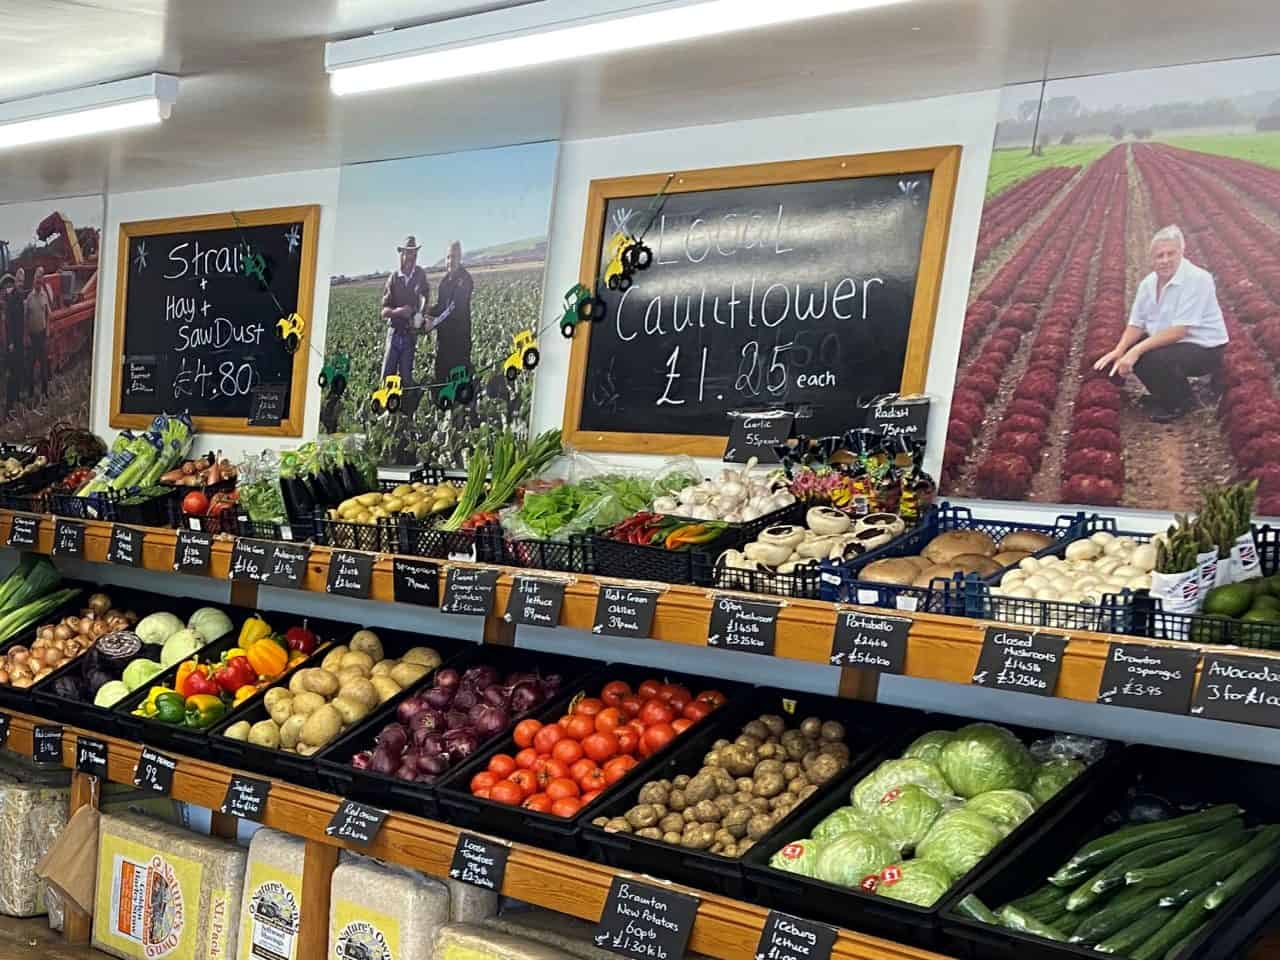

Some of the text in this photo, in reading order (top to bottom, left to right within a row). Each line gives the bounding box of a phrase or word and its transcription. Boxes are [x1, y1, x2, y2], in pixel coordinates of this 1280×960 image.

[163, 241, 252, 279] Stra
[166, 295, 195, 323] Hay
[172, 357, 252, 399] £4.80
[796, 370, 836, 388] each
[719, 599, 742, 613] Open
[993, 633, 1033, 647] Closed
[617, 903, 680, 932] New Potatoes
[209, 922, 222, 957] Pack
[336, 921, 374, 956] Nature's
[771, 932, 811, 955] lettuce
